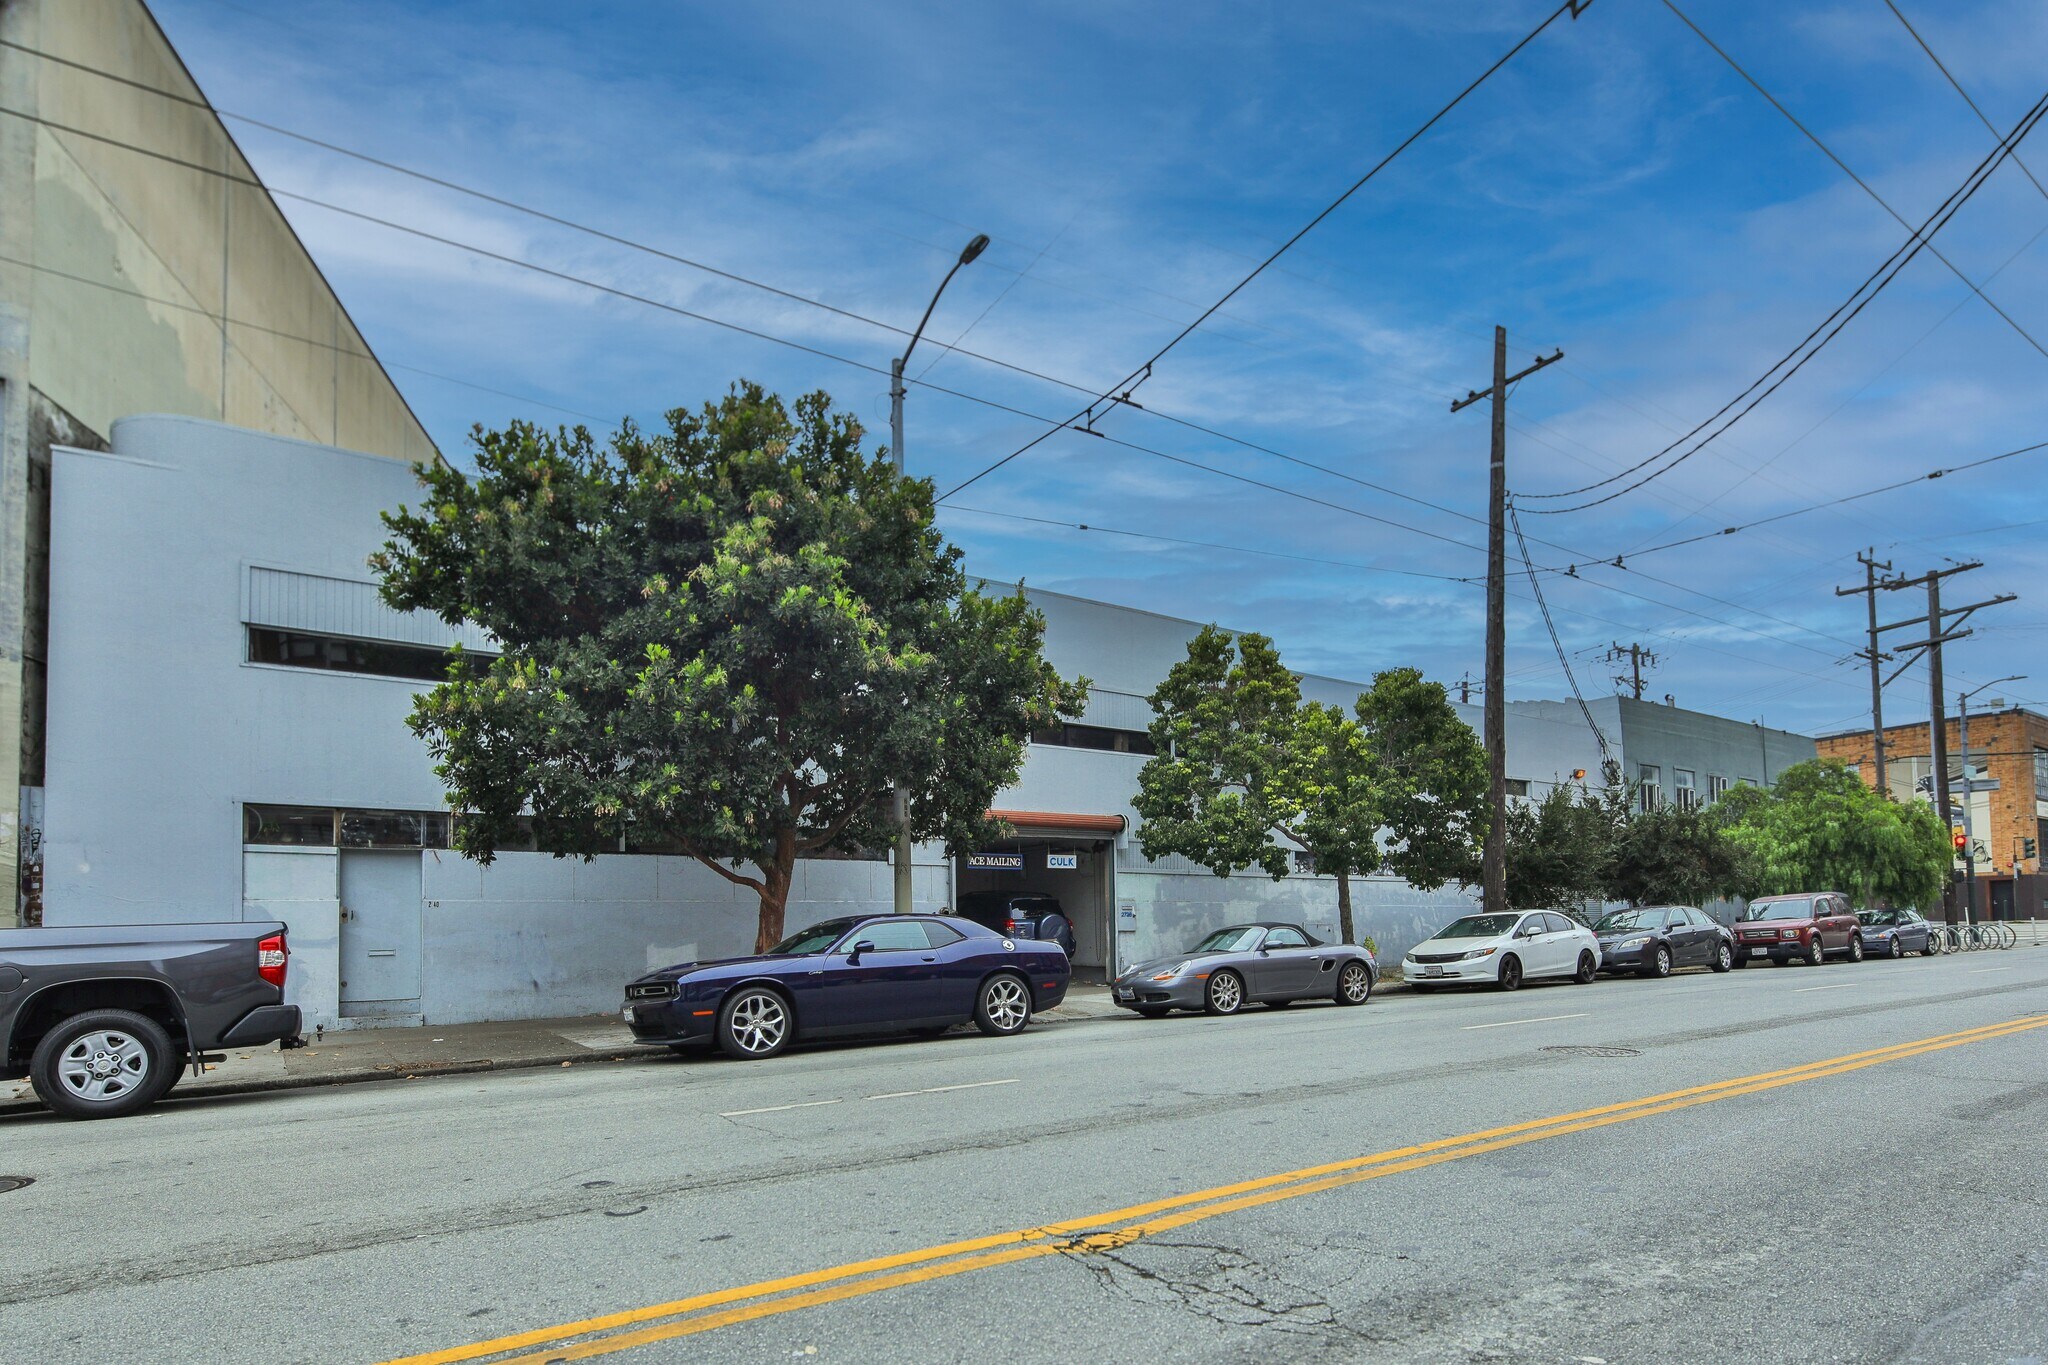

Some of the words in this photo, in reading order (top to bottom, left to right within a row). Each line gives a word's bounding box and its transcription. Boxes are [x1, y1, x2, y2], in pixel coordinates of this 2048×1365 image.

[969, 856, 985, 866] ACE
[986, 857, 1021, 867] MAILING
[1050, 857, 1074, 867] CULK
